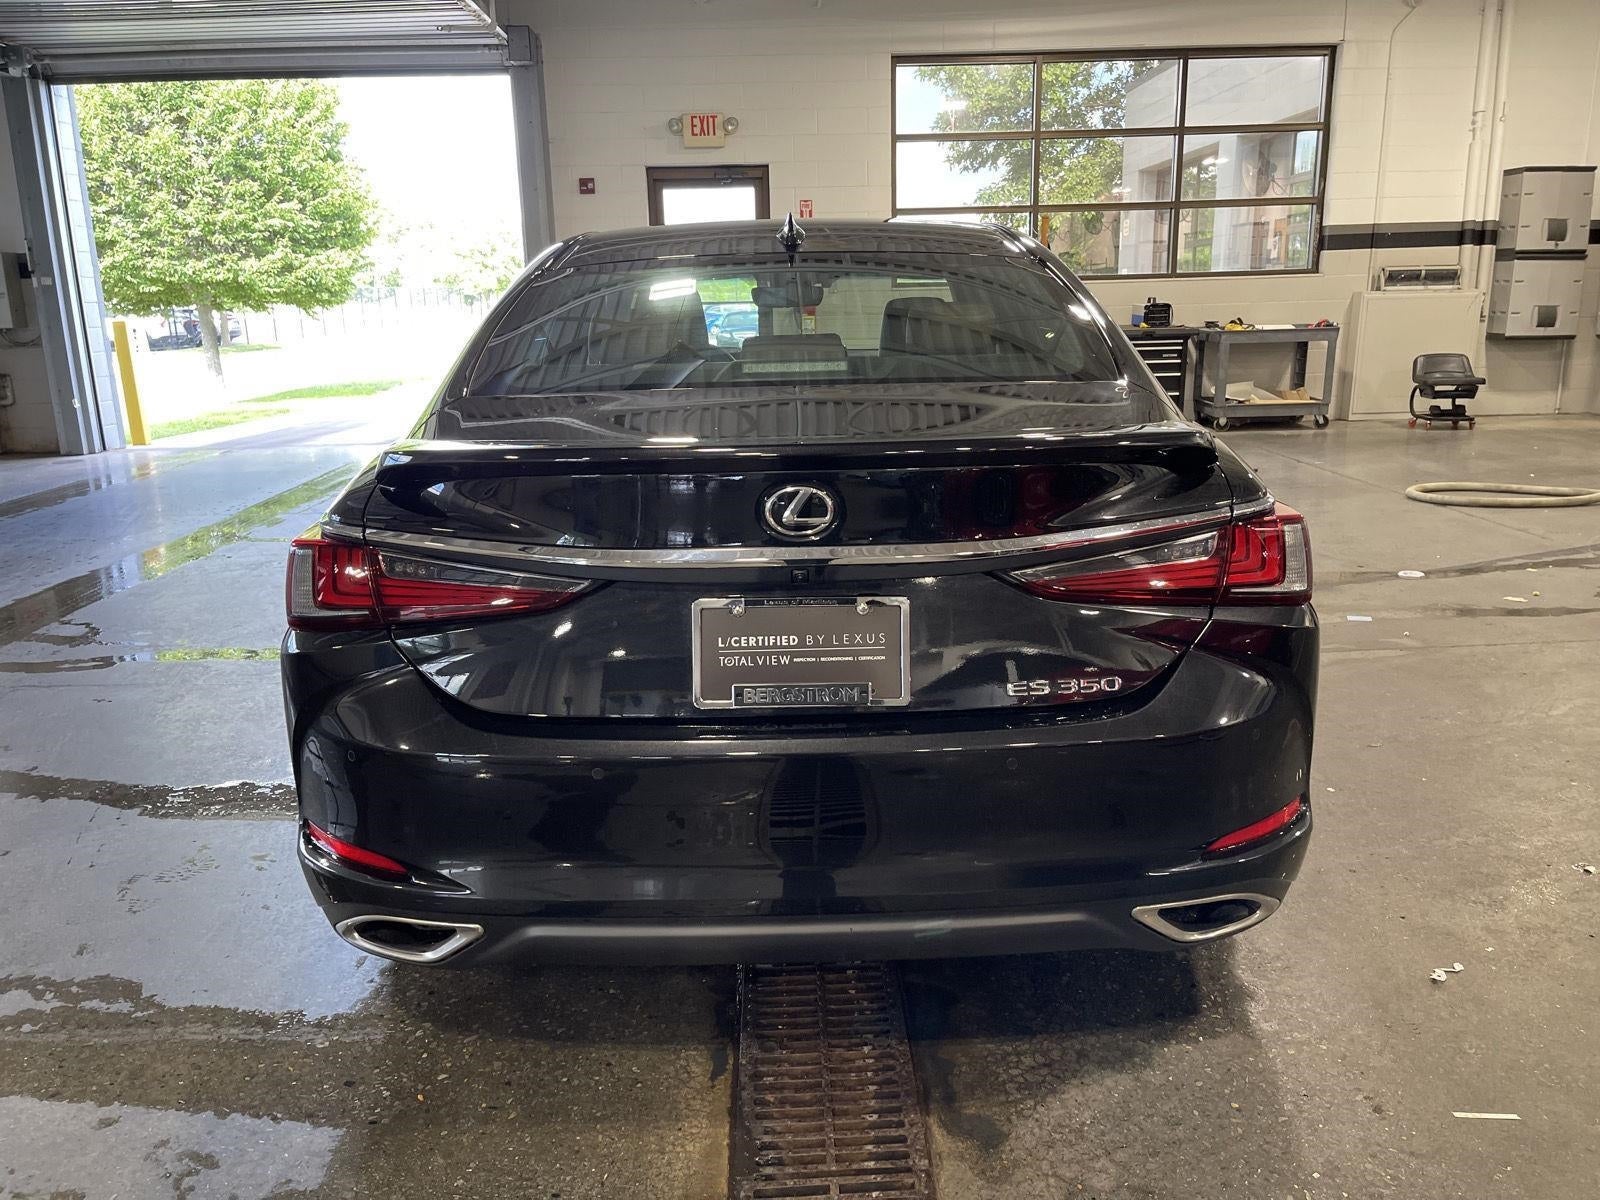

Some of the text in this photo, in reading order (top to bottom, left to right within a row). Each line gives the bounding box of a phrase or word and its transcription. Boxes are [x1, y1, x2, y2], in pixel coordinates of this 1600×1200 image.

[690, 115, 717, 137] EXIT
[718, 632, 886, 647] L/CERTIFIED BY LEXUS
[718, 655, 754, 667] TOTAL
[756, 654, 791, 665] VIEW
[1006, 676, 1122, 696] ES 350
[743, 687, 858, 704] BERGSTROM
